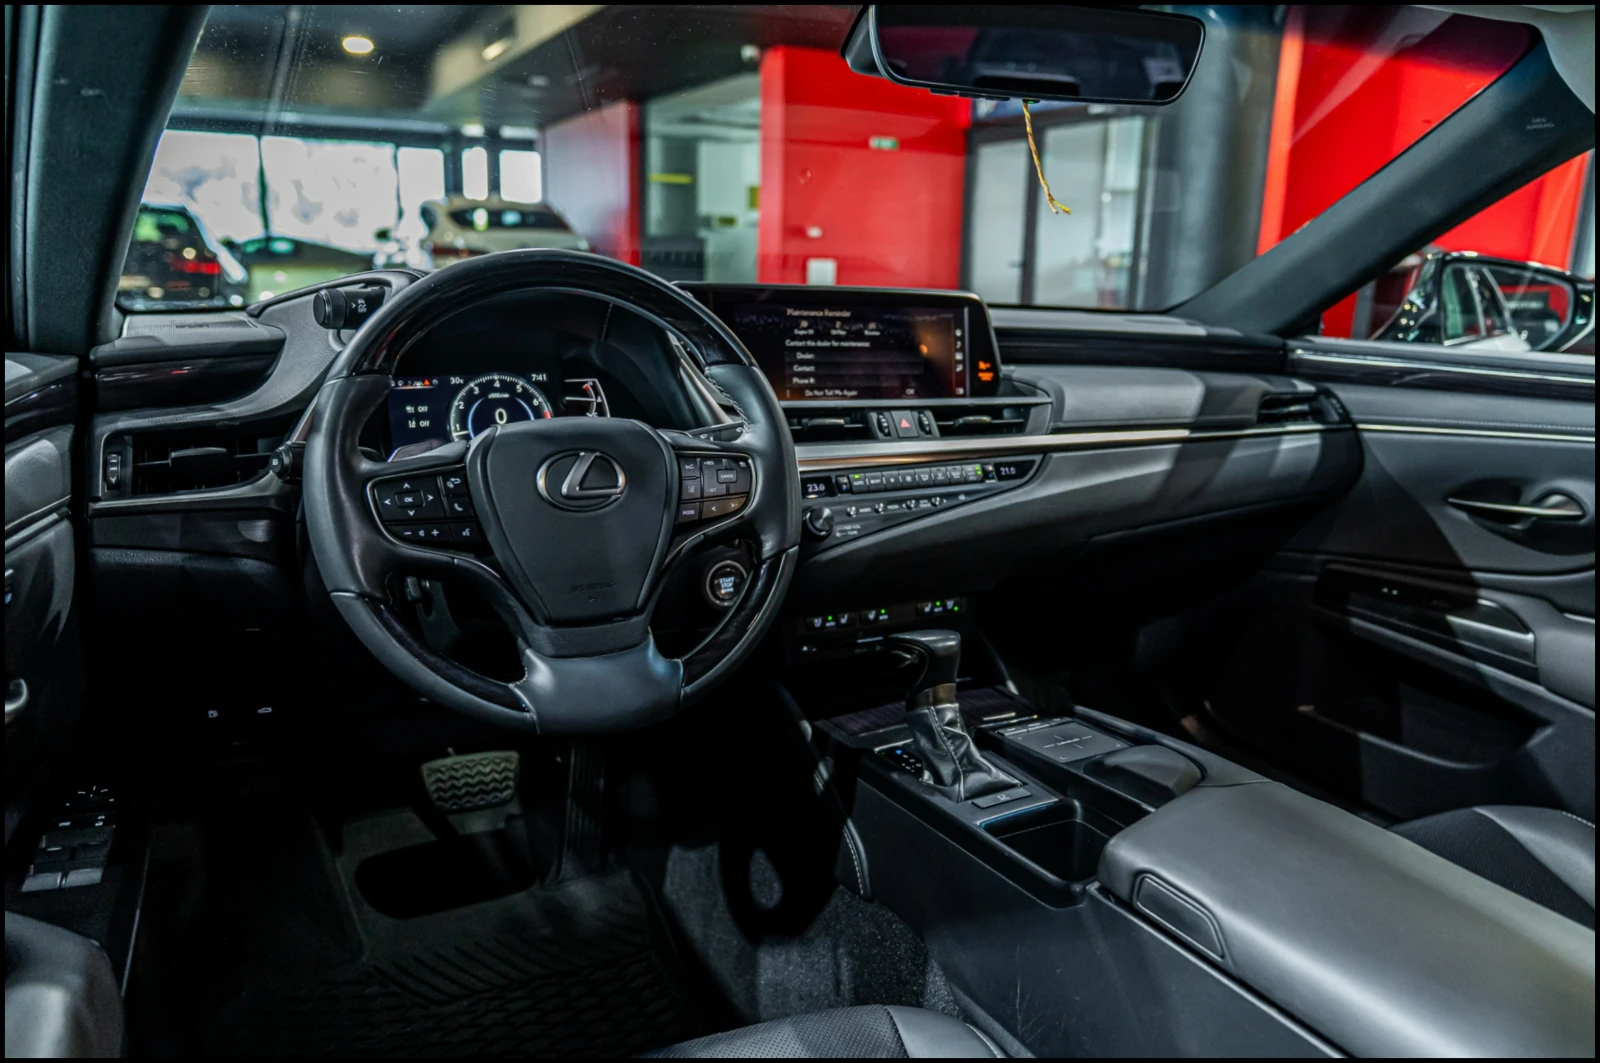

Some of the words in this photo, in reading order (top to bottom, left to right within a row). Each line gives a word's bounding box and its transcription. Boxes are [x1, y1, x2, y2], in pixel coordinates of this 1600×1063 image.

[786, 308, 824, 316] Maintenance
[824, 309, 852, 318] Reminder
[531, 374, 546, 382] 7:41
[494, 380, 500, 388] 4
[473, 386, 480, 394] 3
[516, 384, 522, 393] 5
[843, 390, 858, 398] Again
[458, 402, 464, 410] 2
[532, 398, 539, 406] 6
[495, 408, 507, 424] 0
[807, 483, 826, 492] 23.0
